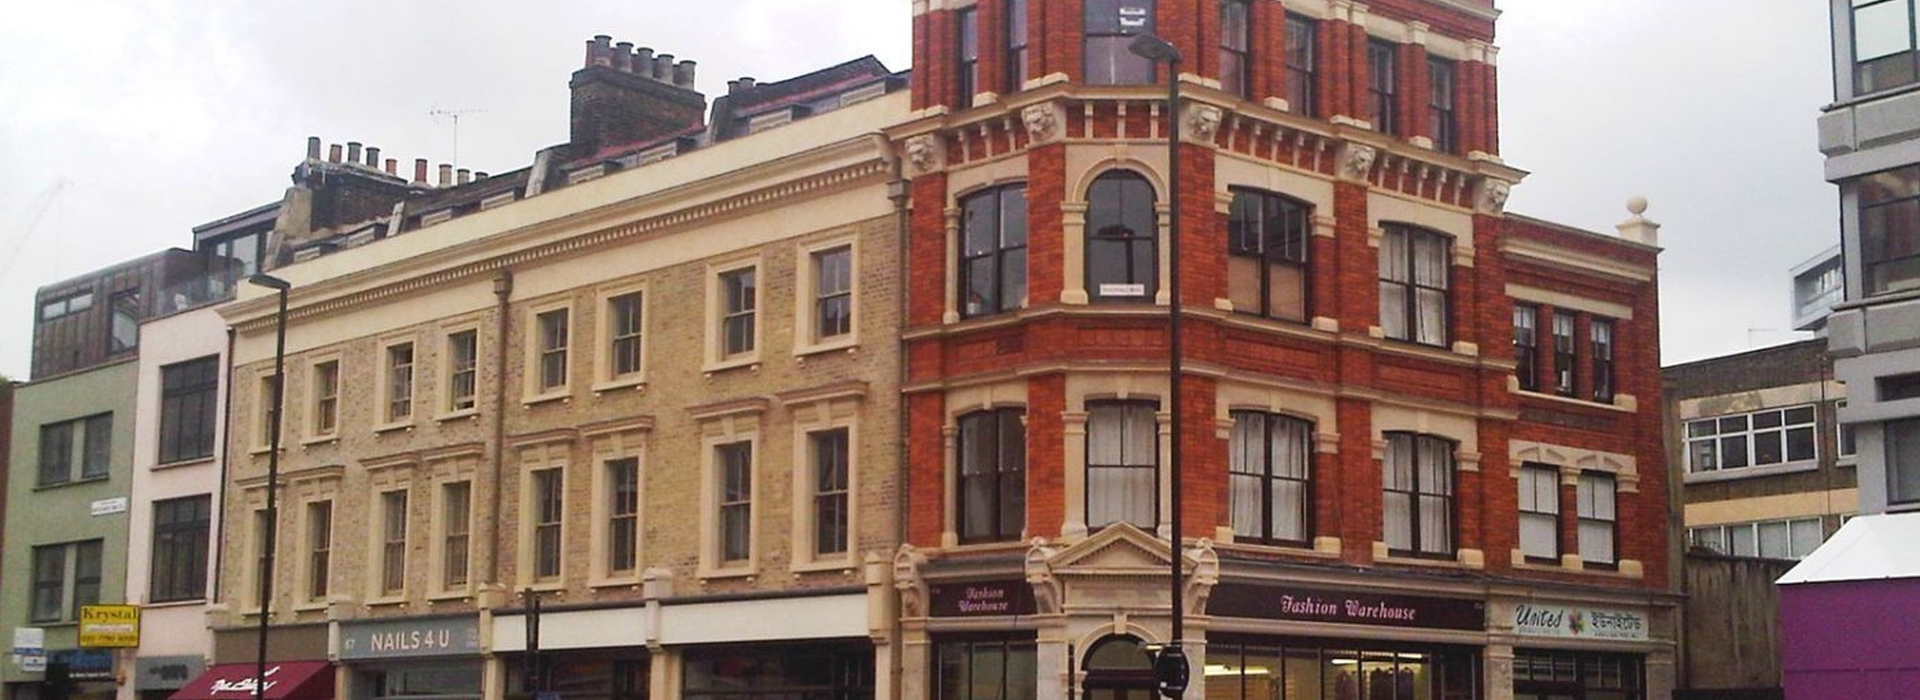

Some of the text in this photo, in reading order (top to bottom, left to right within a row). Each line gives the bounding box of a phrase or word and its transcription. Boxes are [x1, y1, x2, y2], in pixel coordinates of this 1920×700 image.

[966, 587, 1004, 599] Fashion
[83, 607, 137, 622] Krystal
[958, 600, 1008, 612] Warehouse
[1281, 595, 1416, 620] Fashion Warehouse
[1516, 605, 1563, 628] United
[371, 631, 420, 651] NAILS
[425, 629, 434, 648] 4
[440, 629, 449, 647] U
